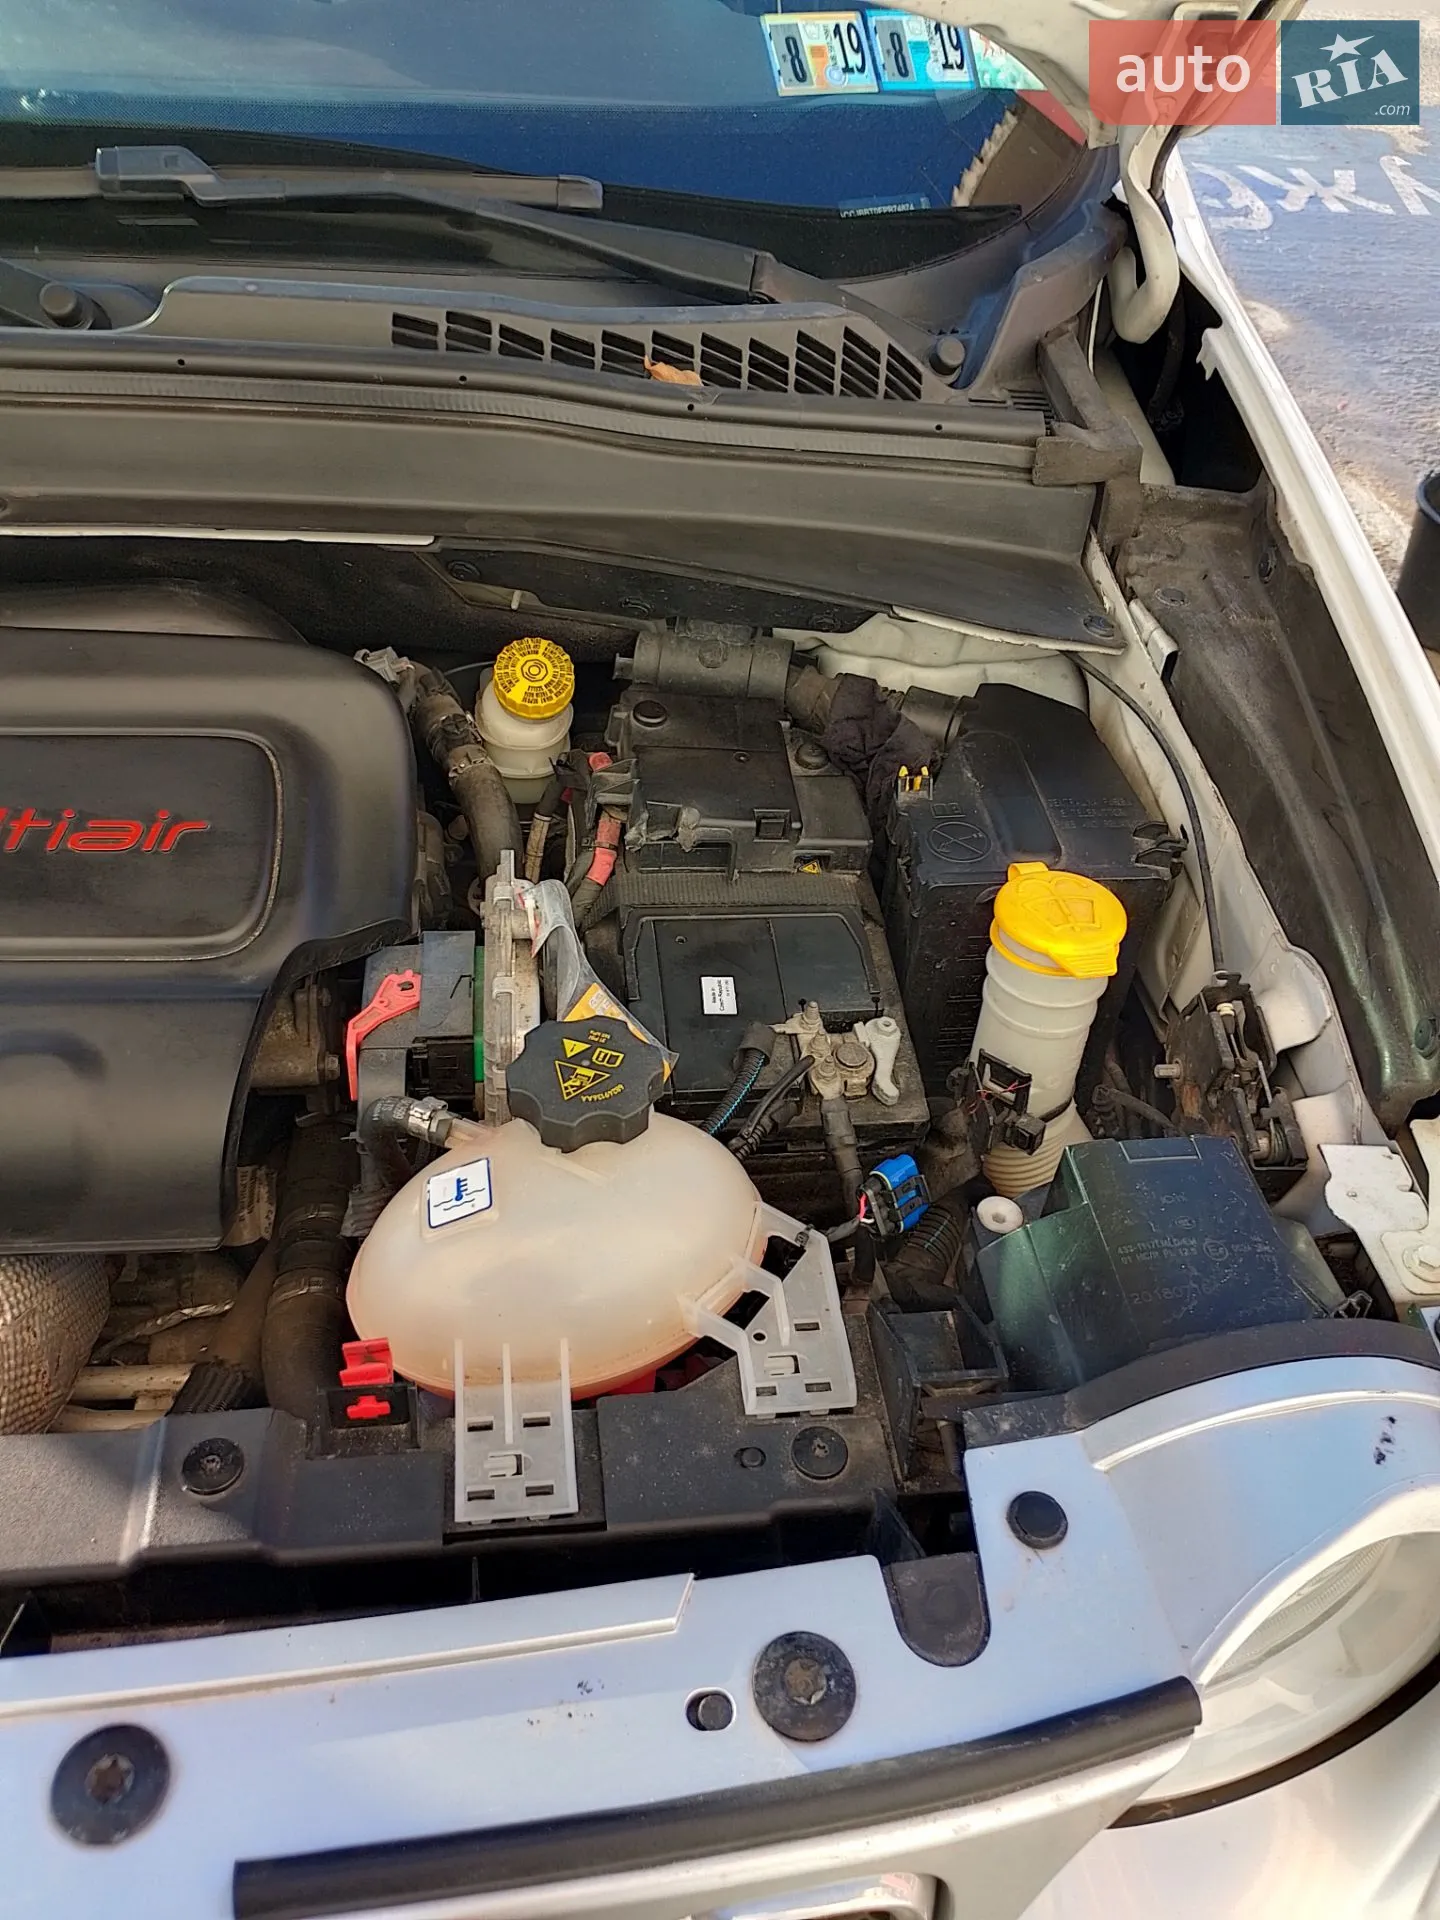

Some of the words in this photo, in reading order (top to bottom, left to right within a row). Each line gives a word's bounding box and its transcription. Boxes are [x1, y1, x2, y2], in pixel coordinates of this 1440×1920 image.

[785, 36, 807, 83] 8
[832, 22, 866, 74] 19
[889, 31, 910, 78] 8
[934, 22, 965, 70] 19
